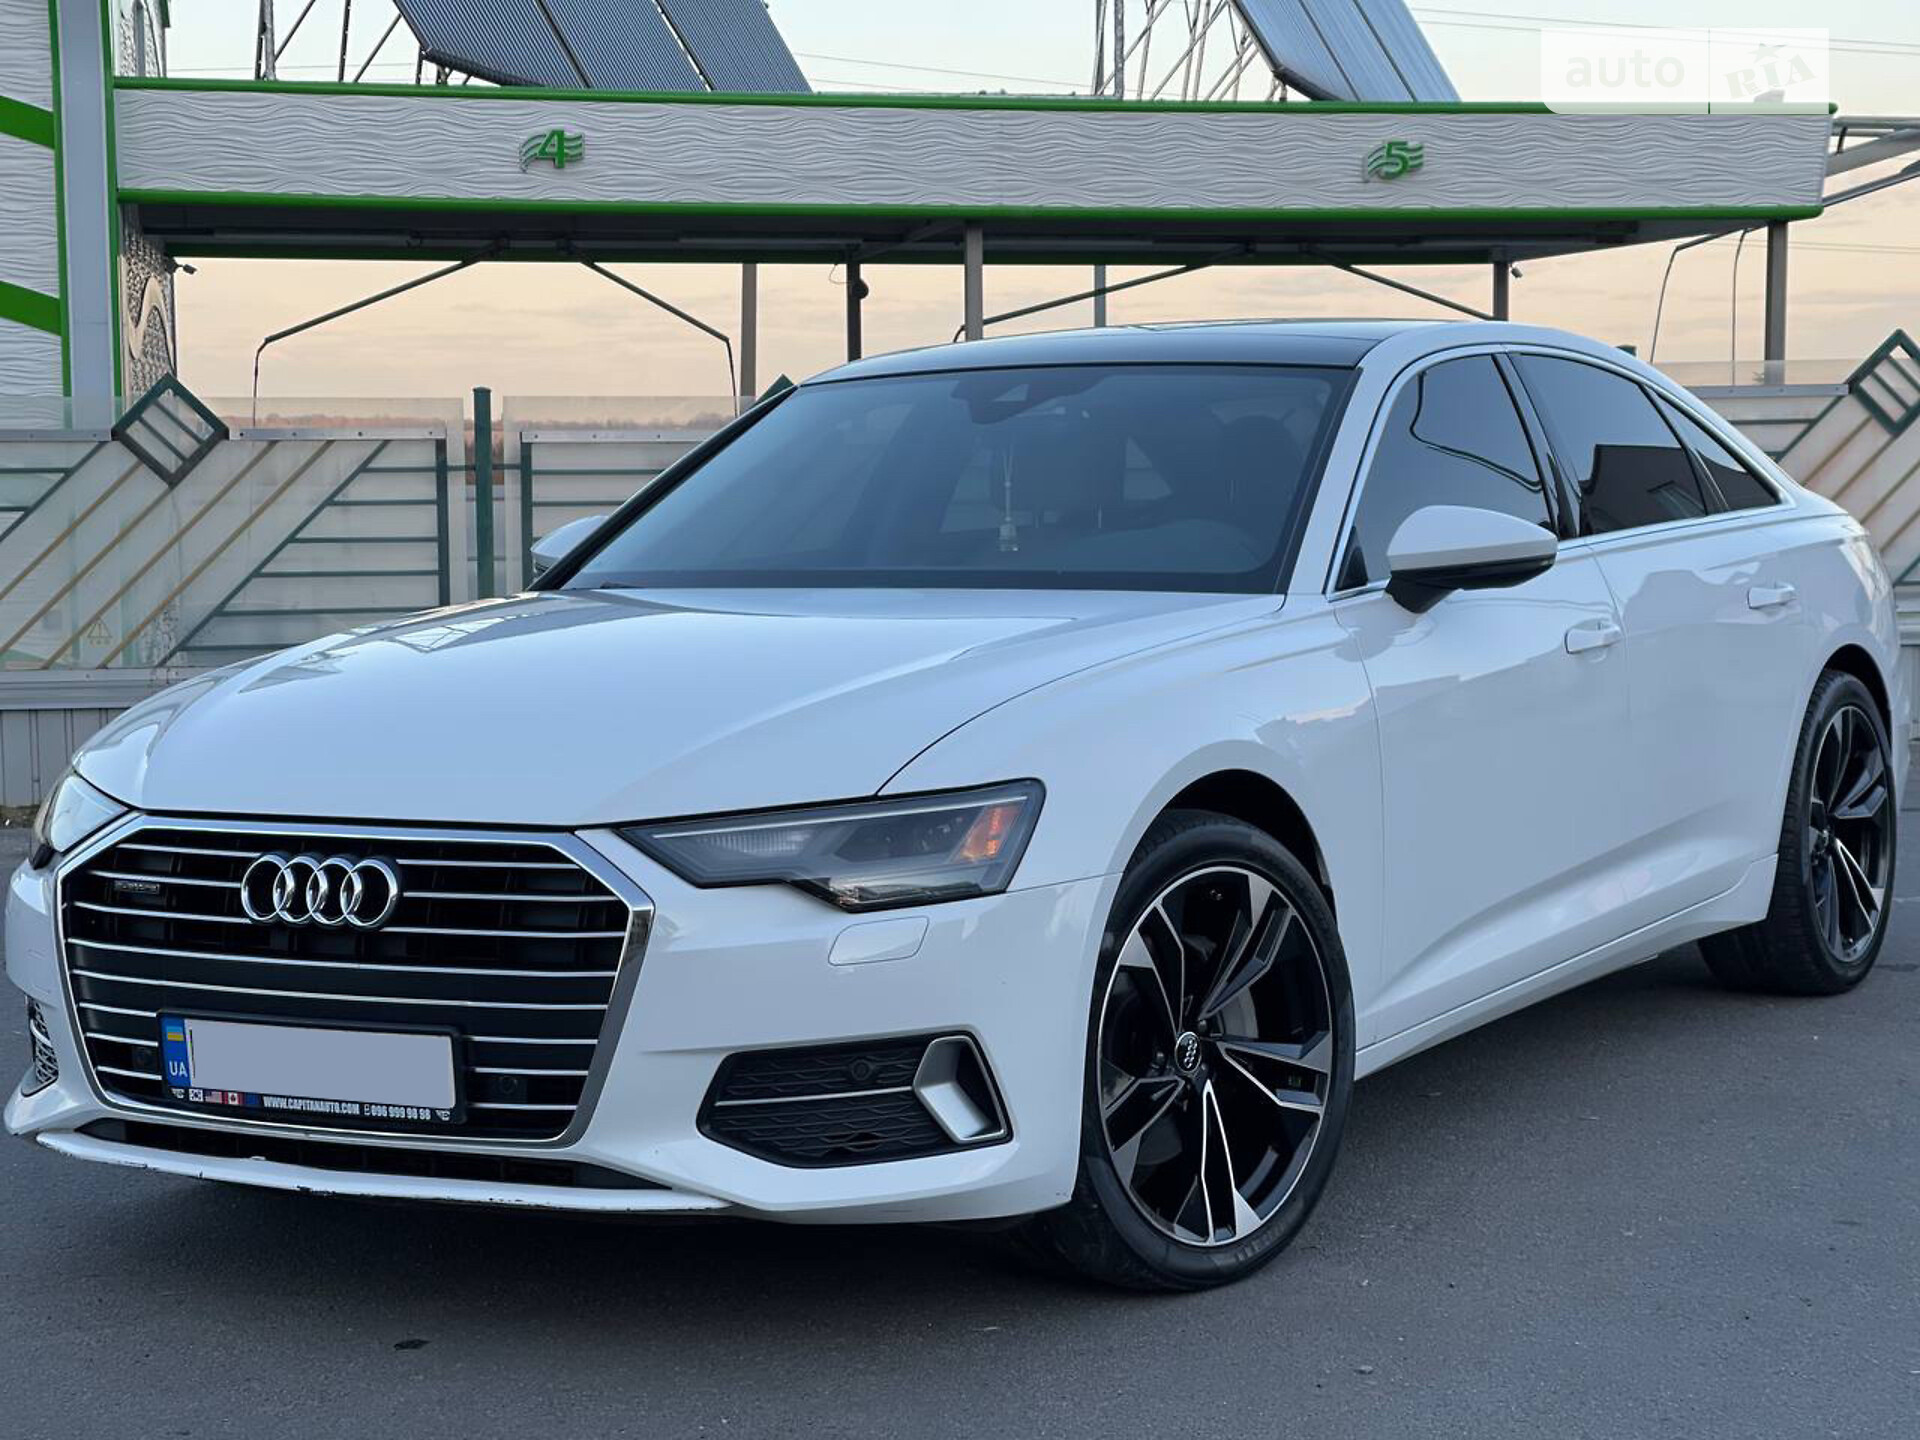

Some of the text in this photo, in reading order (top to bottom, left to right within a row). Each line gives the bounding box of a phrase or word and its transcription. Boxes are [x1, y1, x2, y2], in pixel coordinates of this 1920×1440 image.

[538, 129, 565, 169] 4
[1384, 140, 1409, 179] 5
[169, 1060, 188, 1078] UA
